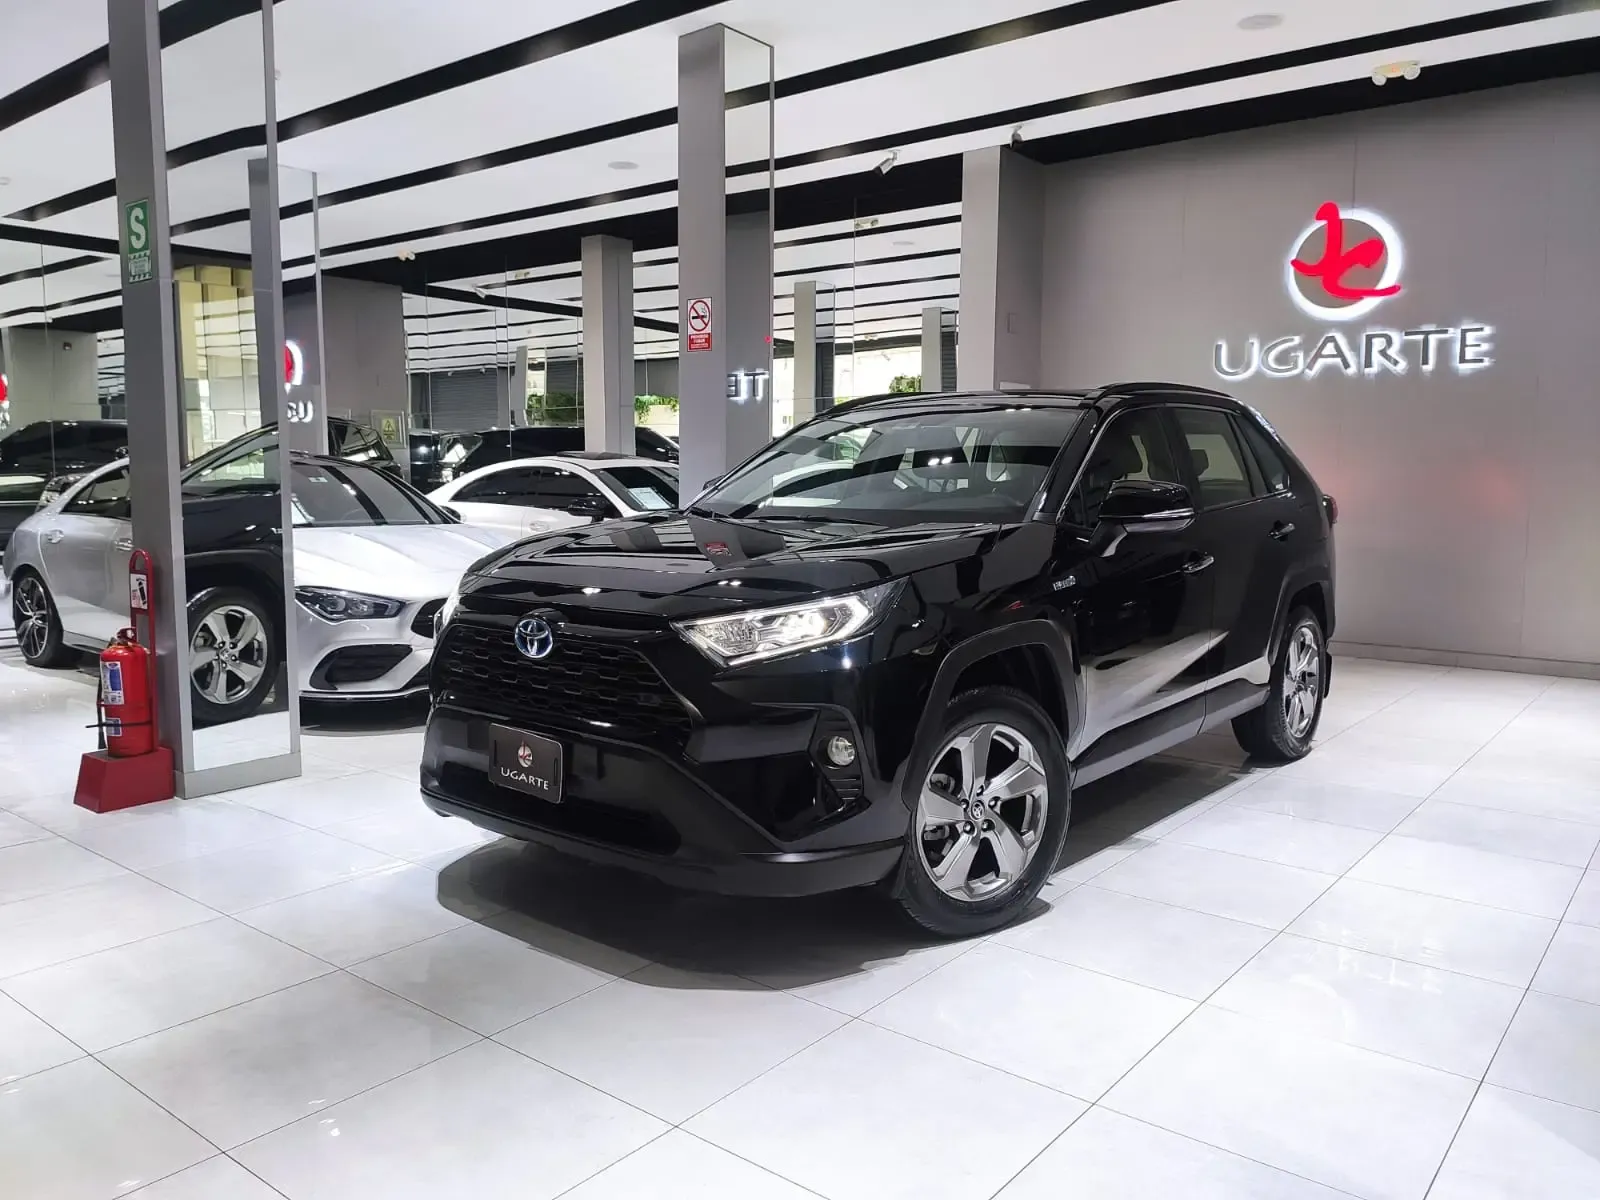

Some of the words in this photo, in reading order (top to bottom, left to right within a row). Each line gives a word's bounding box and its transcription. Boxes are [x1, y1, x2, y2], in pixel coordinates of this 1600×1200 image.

[130, 207, 146, 249] S
[1213, 323, 1494, 380] UGARTE
[501, 766, 549, 790] UGARTE
